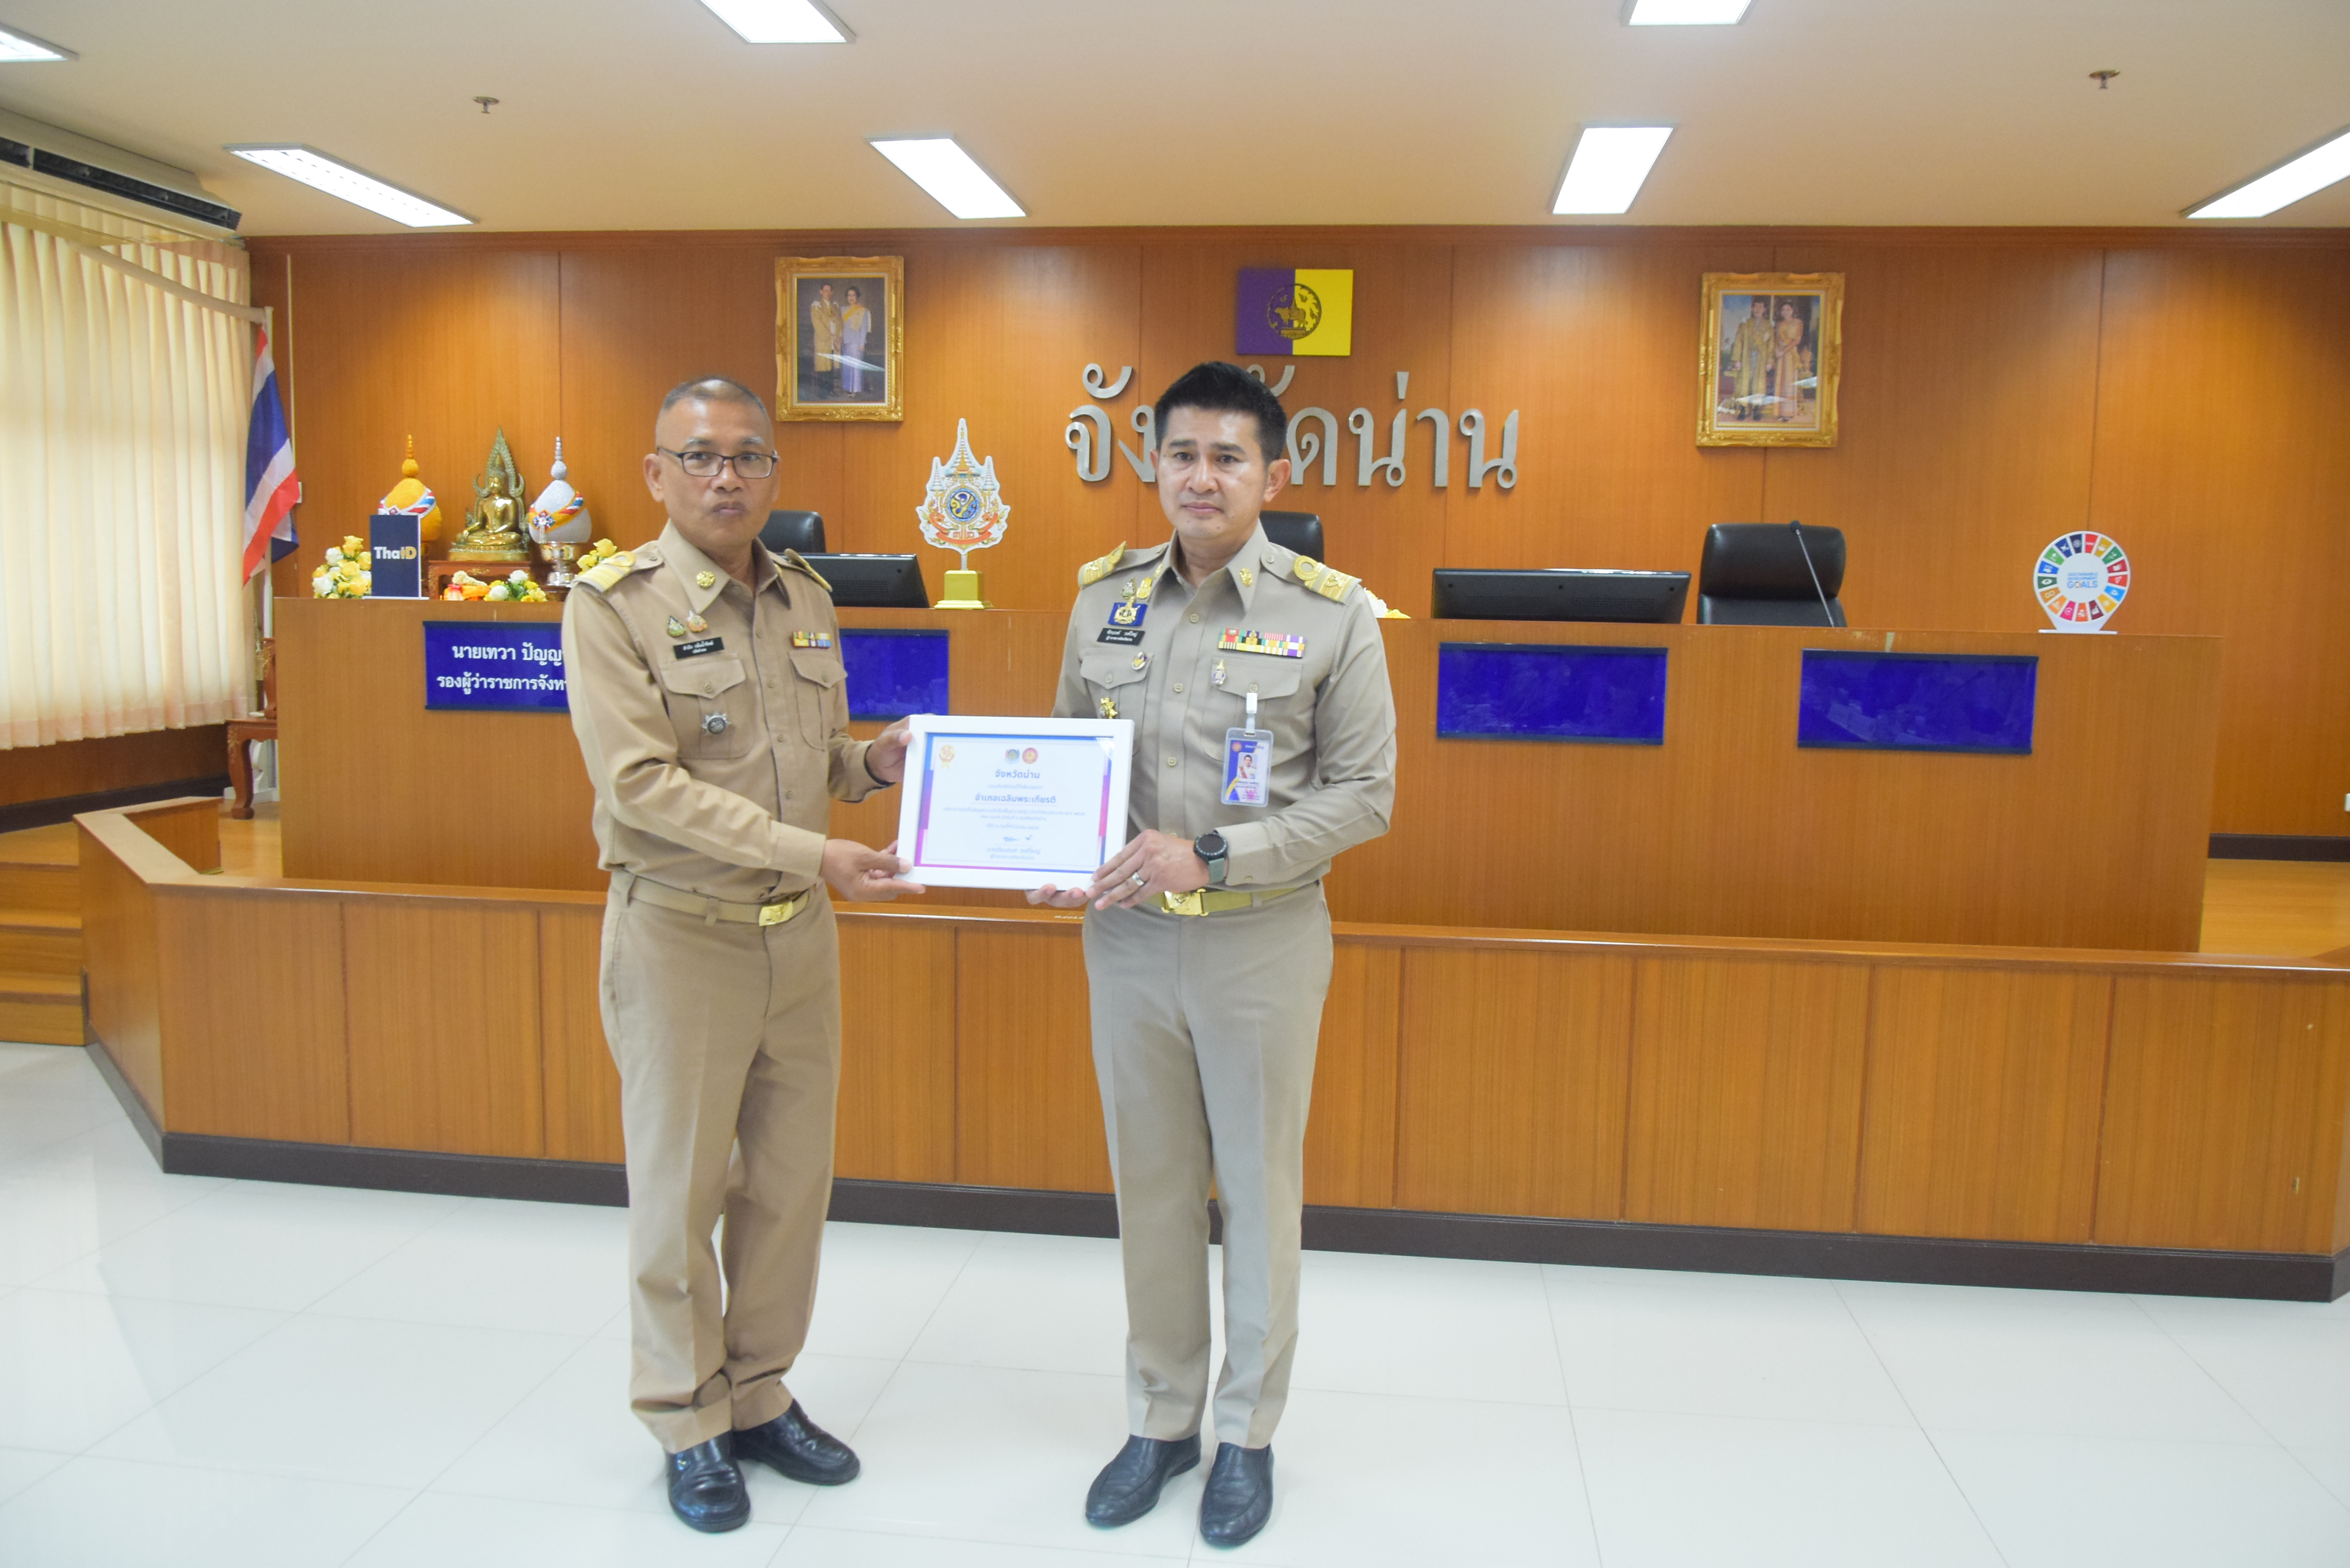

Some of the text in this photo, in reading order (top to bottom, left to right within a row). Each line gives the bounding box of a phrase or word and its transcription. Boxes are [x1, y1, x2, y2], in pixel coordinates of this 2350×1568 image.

[1065, 362, 1519, 489] จังัดน่าน
[452, 642, 563, 666] นายเทวา ปัญญ
[437, 672, 567, 695] รองผู้ว่าราชการจังห
[995, 769, 1041, 779] จังหวัดน่าน
[975, 793, 1056, 804] อำเภอเฉลิมพระเกียรติ
